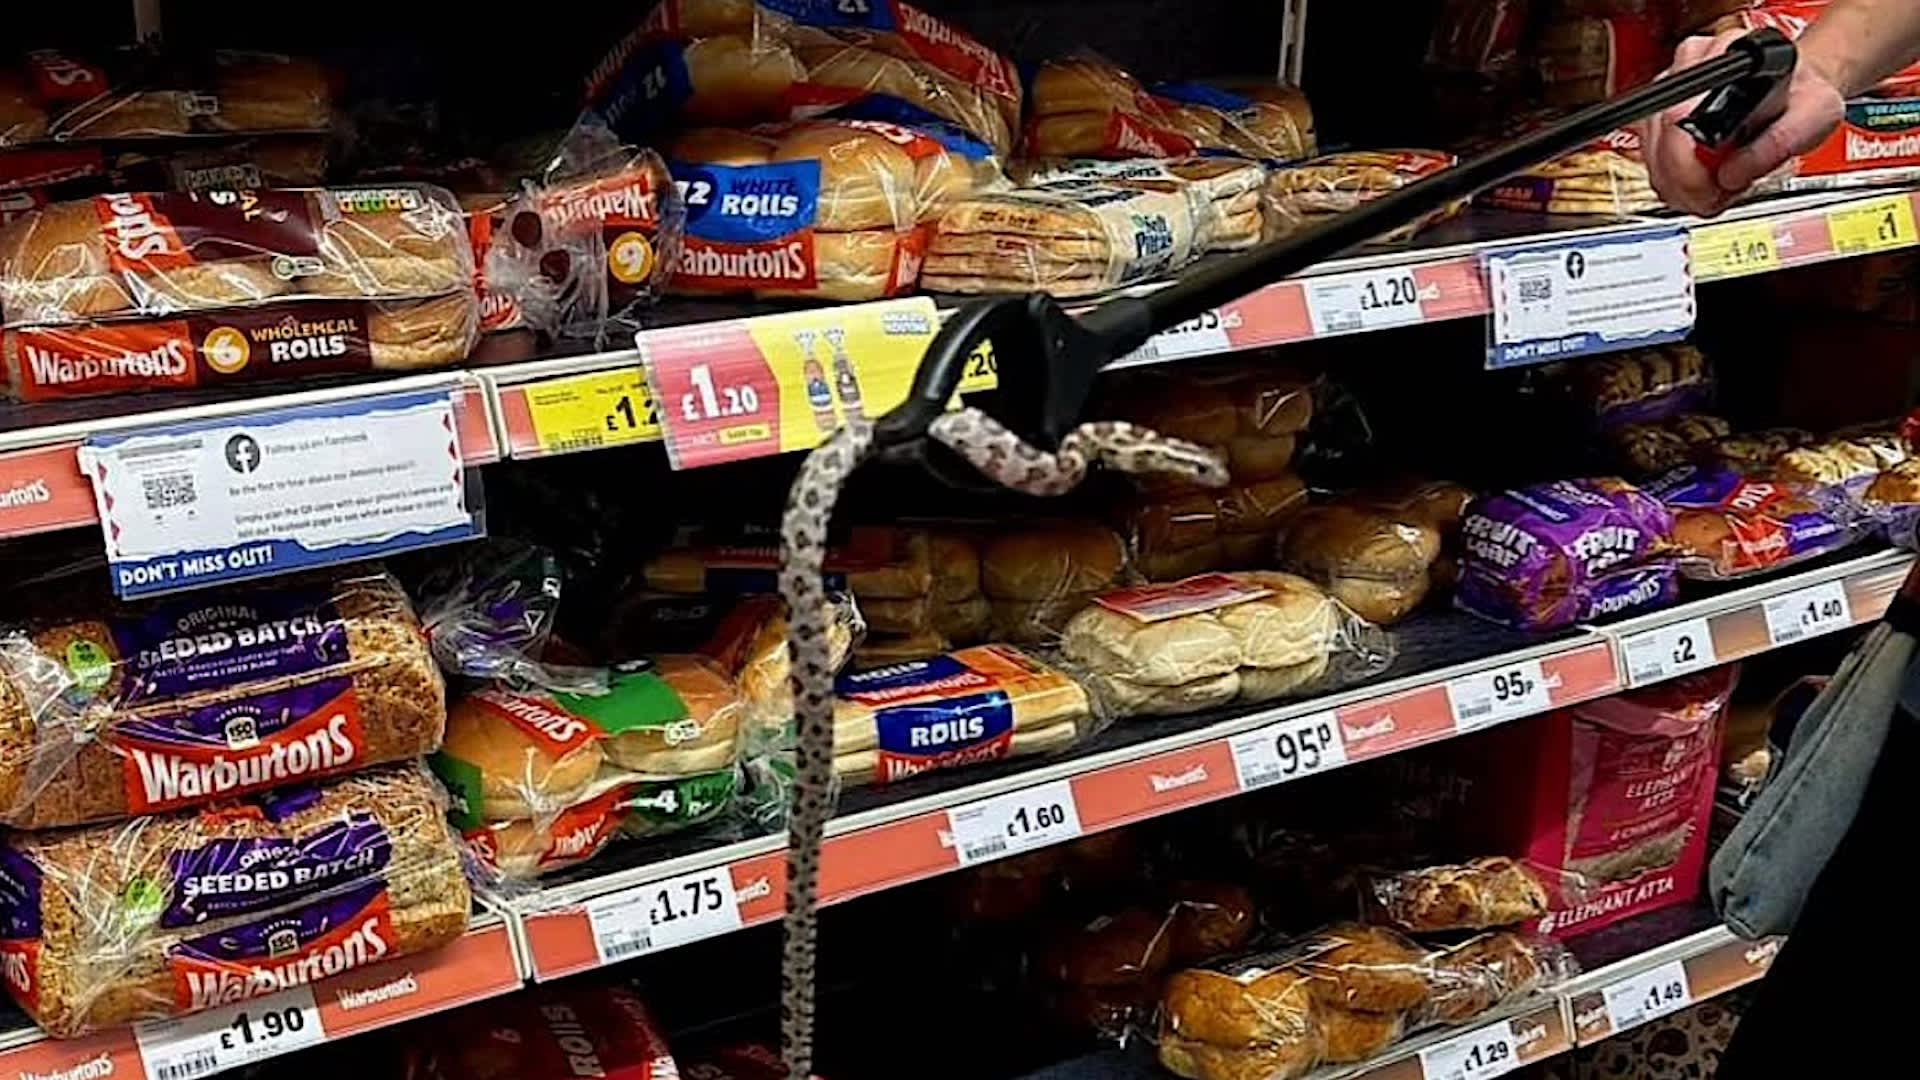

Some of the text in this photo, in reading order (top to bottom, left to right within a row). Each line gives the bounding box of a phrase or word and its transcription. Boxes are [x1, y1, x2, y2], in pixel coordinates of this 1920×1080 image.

[721, 194, 798, 217] ROLLS
[1877, 212, 1897, 240] £1
[1361, 276, 1417, 311] £1.20
[250, 319, 359, 343] WHOLEMEAL
[215, 335, 242, 366] 6
[270, 335, 346, 363] ROLLS
[681, 363, 759, 421] £1.20
[1575, 526, 1641, 561] FRUIT
[119, 544, 273, 587] DON'T MISS OUT!
[1801, 599, 1842, 625] £1.40
[236, 614, 324, 648] BATCH
[1673, 636, 1696, 663] £2
[1494, 670, 1534, 702] 95p
[910, 716, 985, 748] ROLLS
[1276, 721, 1332, 774] 95p
[130, 713, 355, 804] Warburtons
[1007, 803, 1065, 837] £1.60
[183, 846, 375, 896] SEEDED BATCH
[650, 877, 723, 926] £1.75
[1557, 875, 1675, 928] ELEPHANT ATTA
[186, 917, 388, 1010] Warburtons
[1644, 981, 1683, 1011] £1.49
[220, 1006, 305, 1050] £1.90
[1464, 1040, 1510, 1071] £1.29
